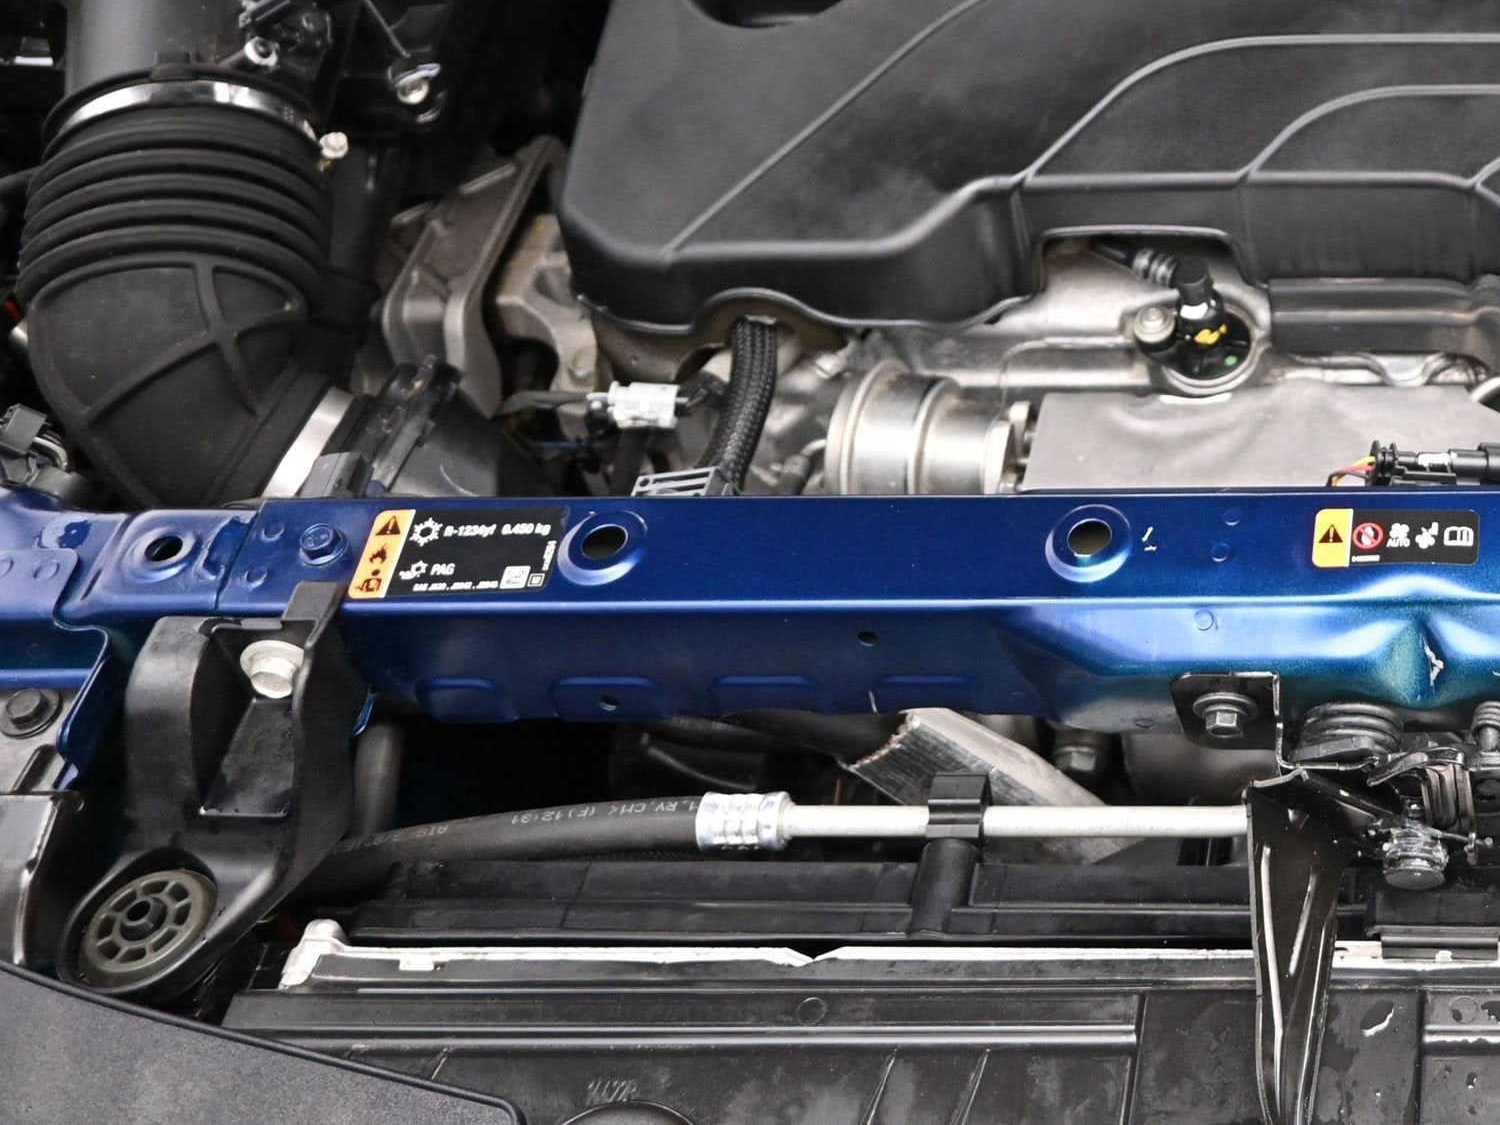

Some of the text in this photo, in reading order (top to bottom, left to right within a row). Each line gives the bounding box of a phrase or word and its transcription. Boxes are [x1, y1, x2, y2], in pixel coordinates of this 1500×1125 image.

[443, 523, 497, 538] R-1234yf
[534, 522, 551, 536] kg
[1386, 538, 1410, 548] AUTO
[430, 563, 455, 576] PAG
